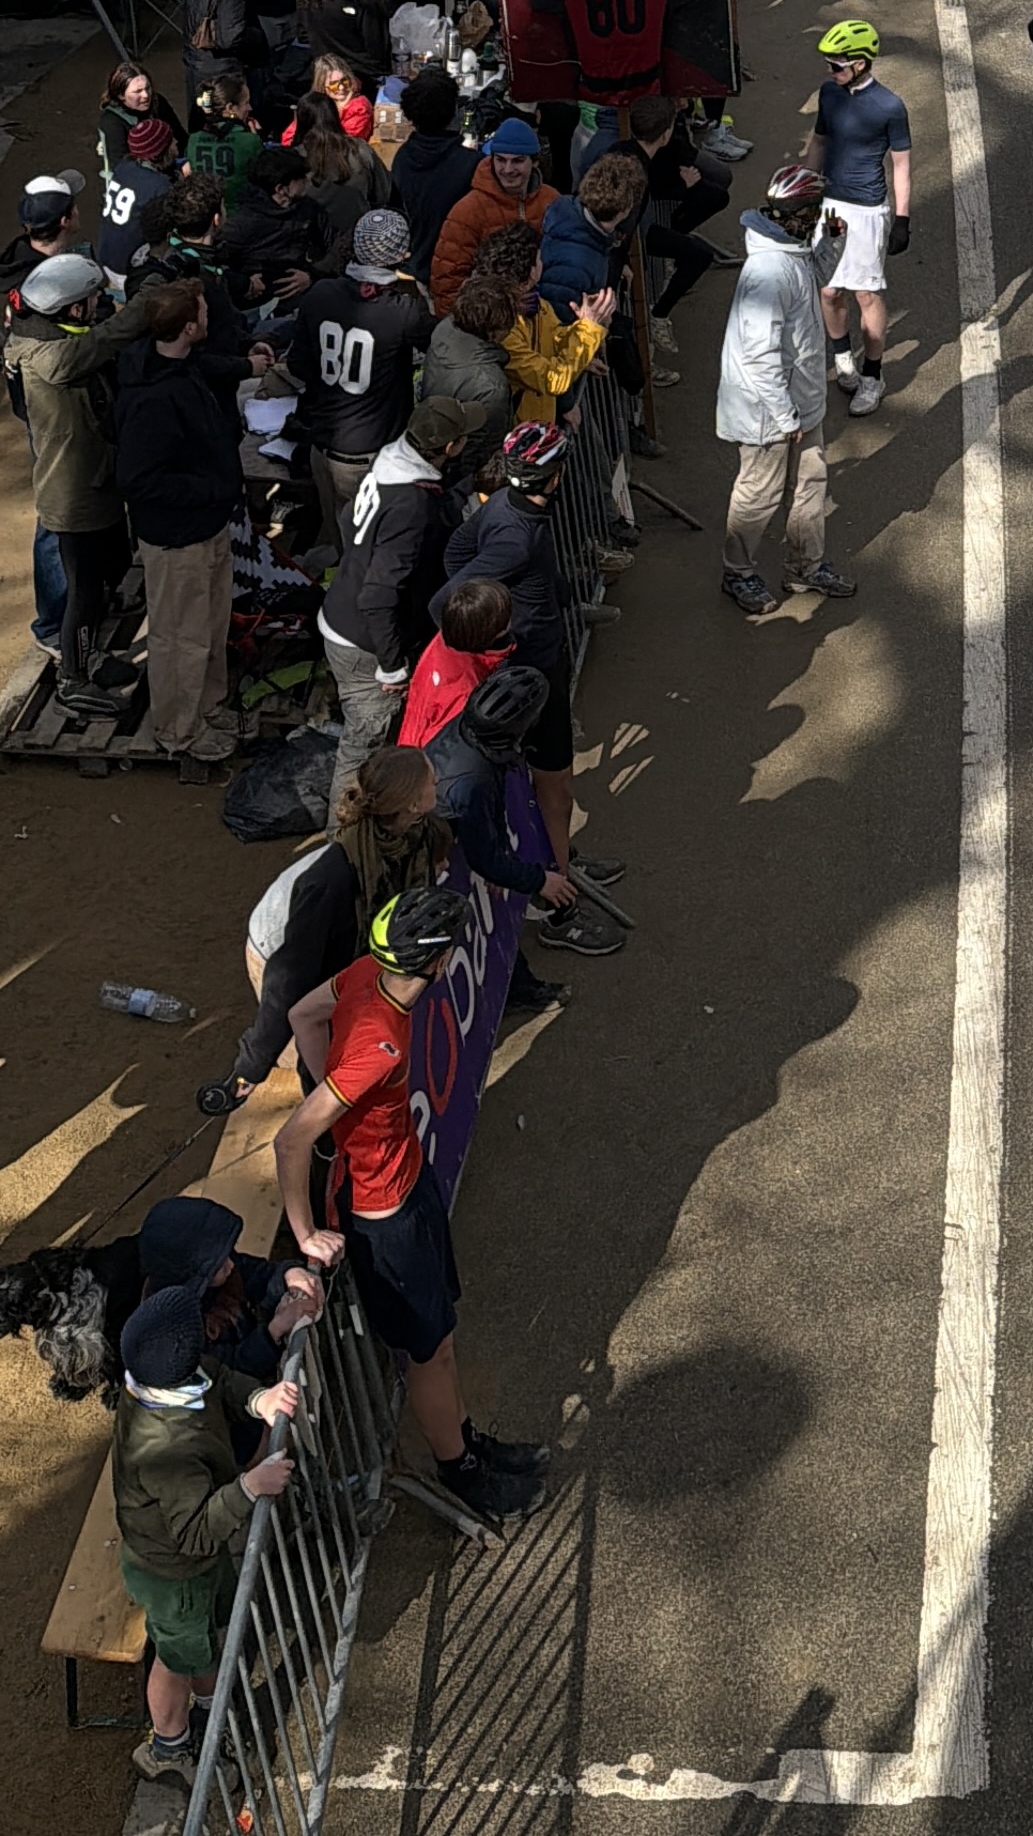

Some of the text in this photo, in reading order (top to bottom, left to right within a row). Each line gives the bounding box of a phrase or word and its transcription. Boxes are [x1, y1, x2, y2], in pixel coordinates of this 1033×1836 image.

[194, 145, 235, 177] 59
[102, 180, 136, 226] 59
[319, 320, 375, 396] 80
